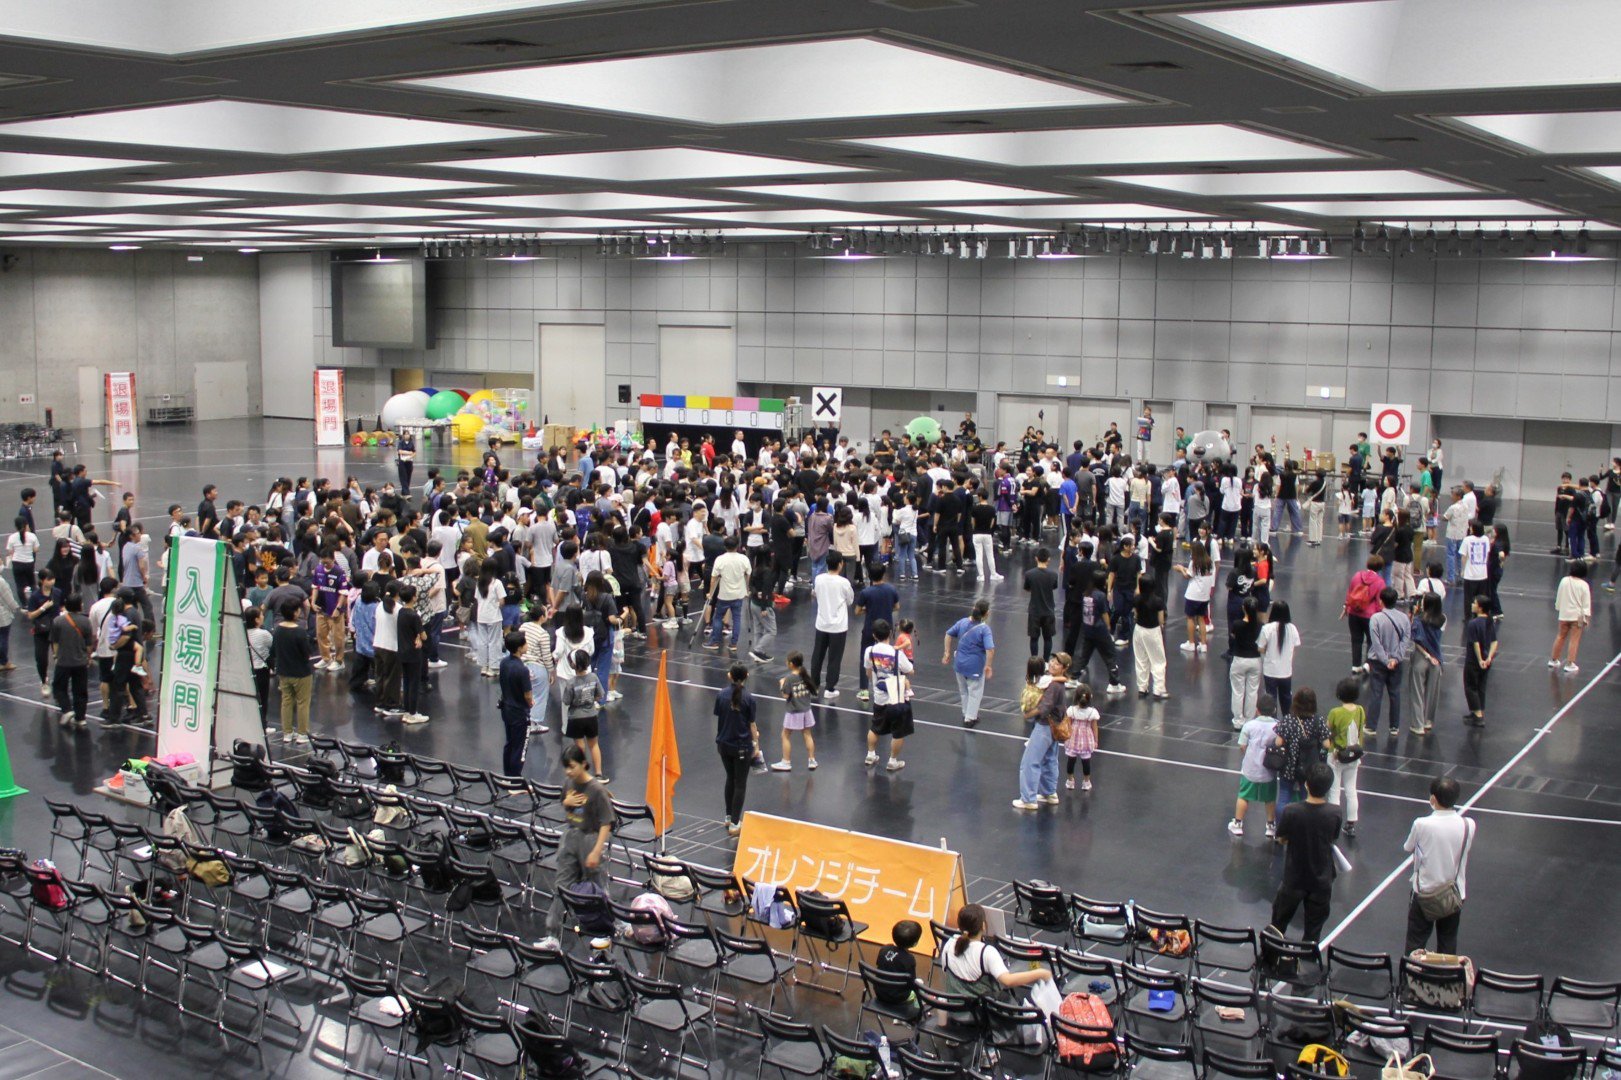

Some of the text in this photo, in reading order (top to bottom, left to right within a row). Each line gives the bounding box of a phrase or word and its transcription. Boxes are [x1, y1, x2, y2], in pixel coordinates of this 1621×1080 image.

[113, 382, 131, 435] 退場門
[320, 380, 337, 431] 退場門
[171, 566, 209, 731] 入場門
[743, 845, 934, 918] オレンジチーム
